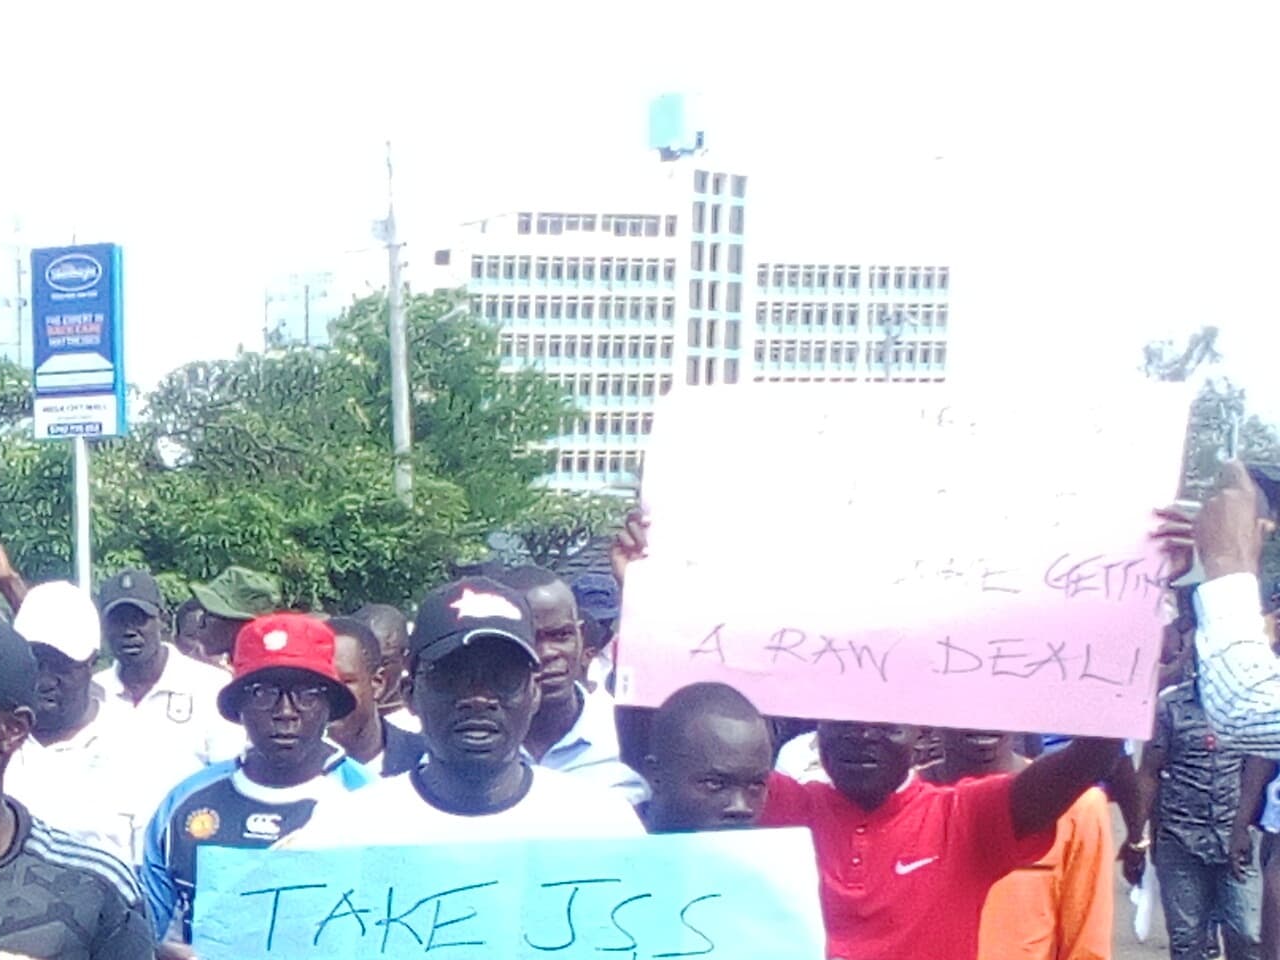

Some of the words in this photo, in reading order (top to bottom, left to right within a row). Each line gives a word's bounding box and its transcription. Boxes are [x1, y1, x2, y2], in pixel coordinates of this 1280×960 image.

[687, 621, 726, 665] A
[763, 626, 904, 682] RAW
[241, 880, 499, 954] TAKE
[523, 878, 724, 958] JSS
